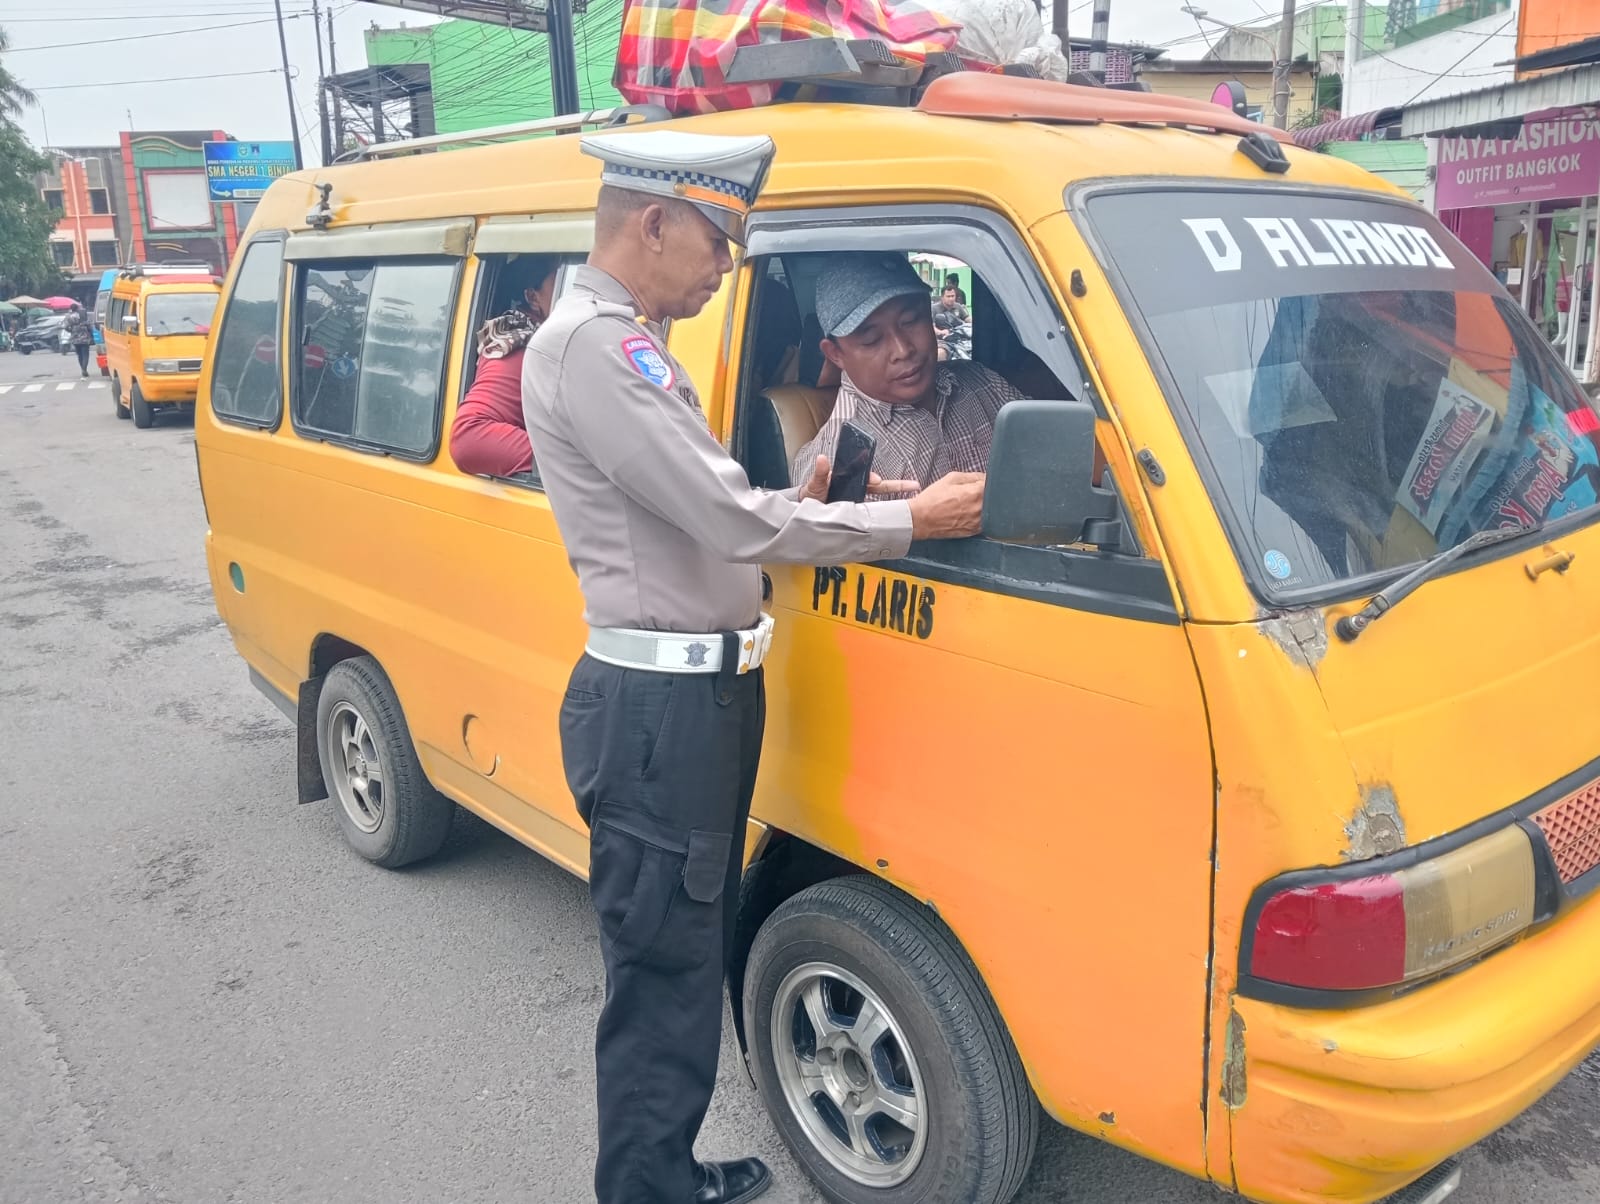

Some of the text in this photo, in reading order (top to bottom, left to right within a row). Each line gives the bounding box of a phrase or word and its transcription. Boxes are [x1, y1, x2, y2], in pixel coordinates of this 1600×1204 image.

[1442, 133, 1497, 163] NAYA
[208, 165, 226, 177] SMA
[229, 164, 258, 177] NEGERI
[1456, 153, 1581, 184] OUTFIT BANGKOK
[1181, 217, 1456, 272] D ALIANDO
[812, 566, 936, 640] PT. LARIS
